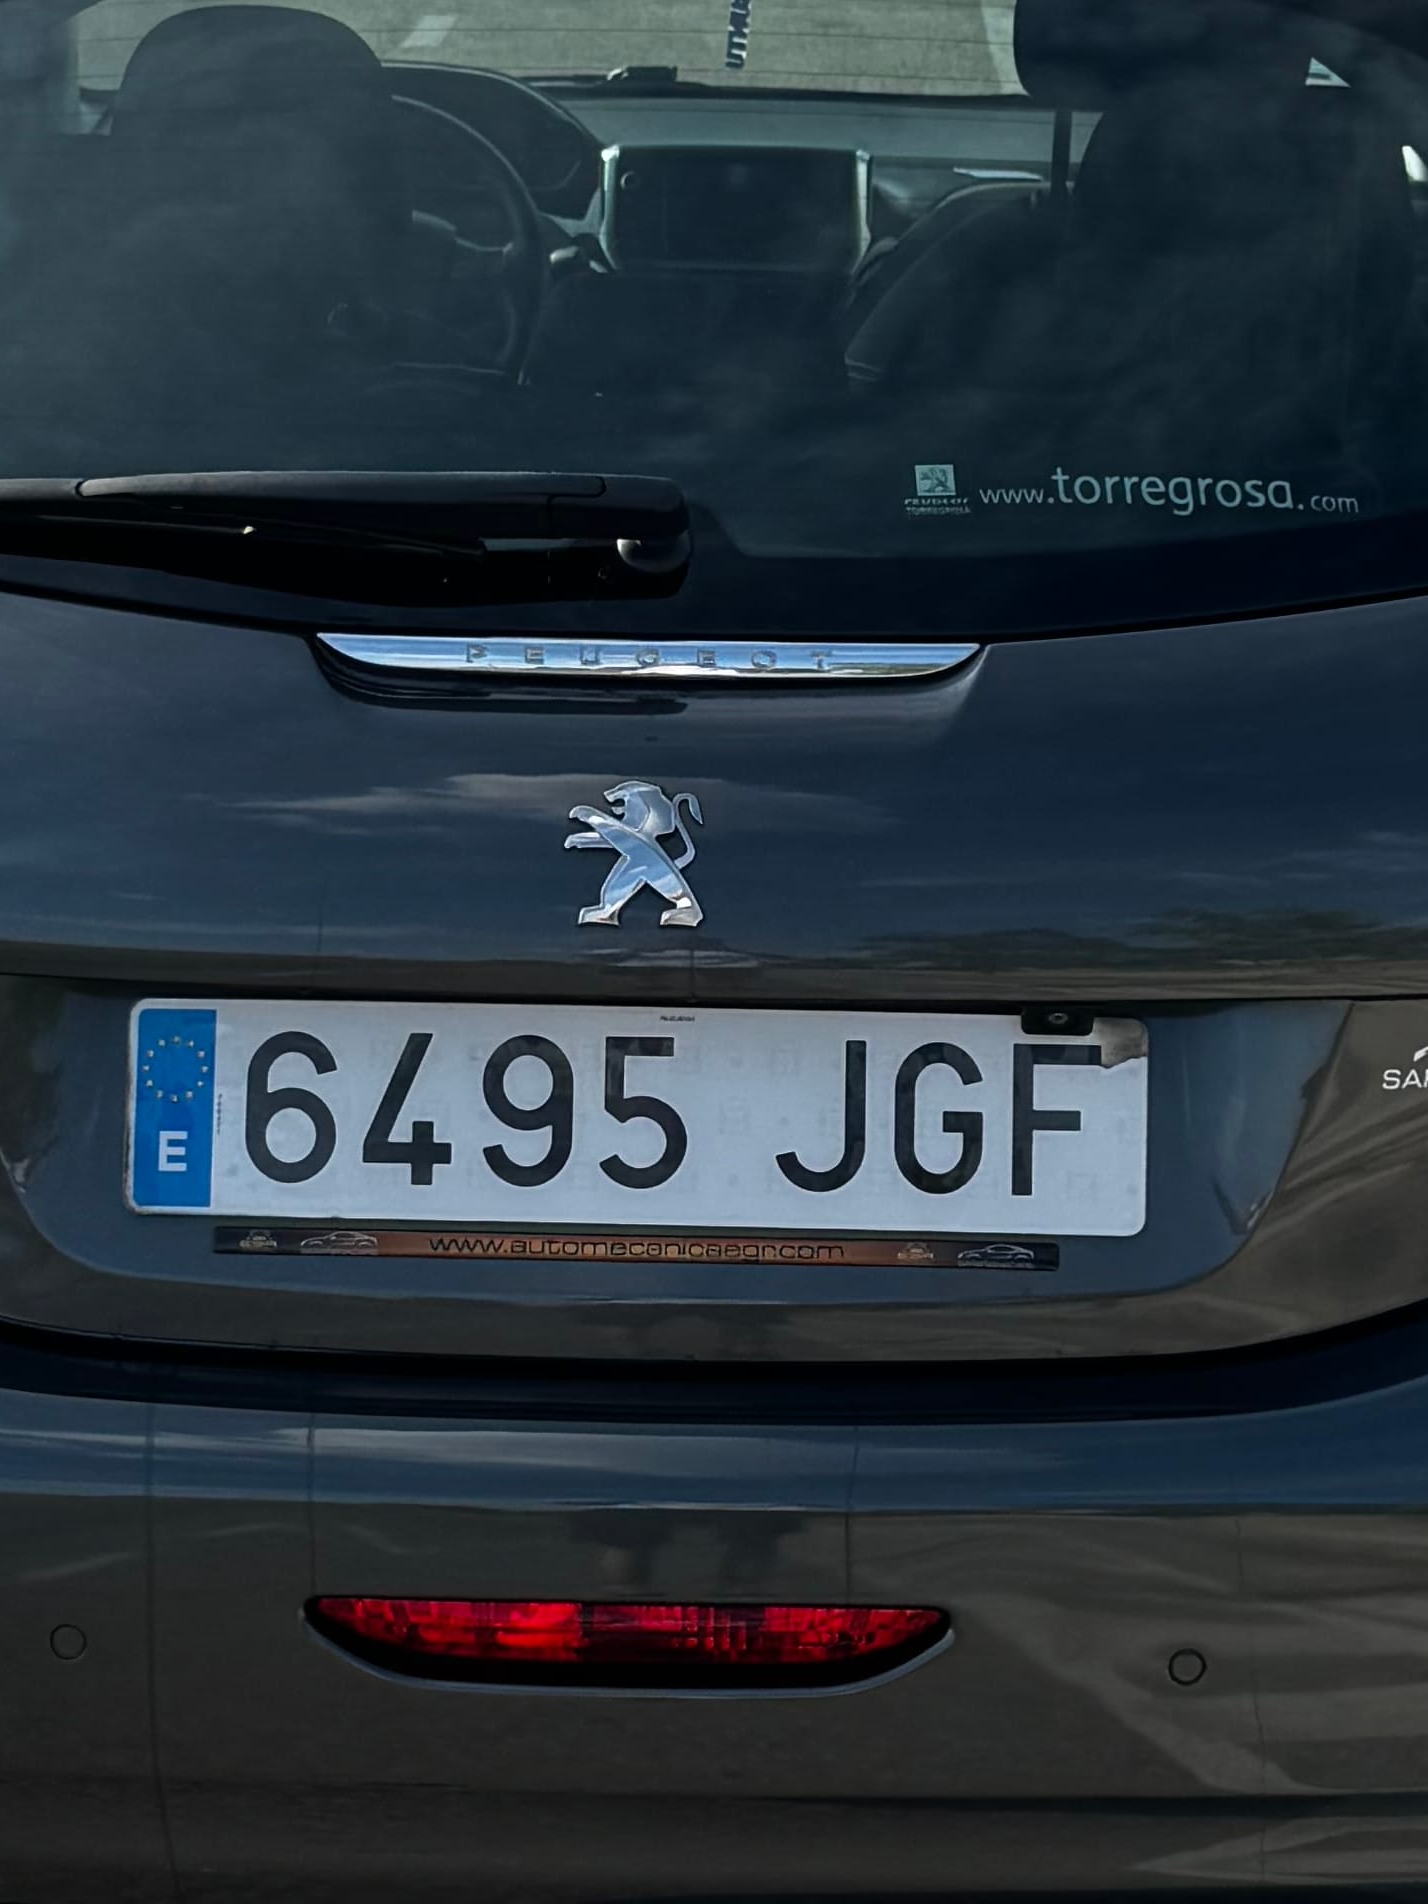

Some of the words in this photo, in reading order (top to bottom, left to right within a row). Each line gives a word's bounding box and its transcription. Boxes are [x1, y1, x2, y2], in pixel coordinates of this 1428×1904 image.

[979, 466, 1360, 516] www.torregrosa.com
[466, 643, 834, 671] PEUGEOT
[244, 1030, 689, 1191] 6495
[775, 1038, 1103, 1197] JGF
[158, 1130, 188, 1172] E
